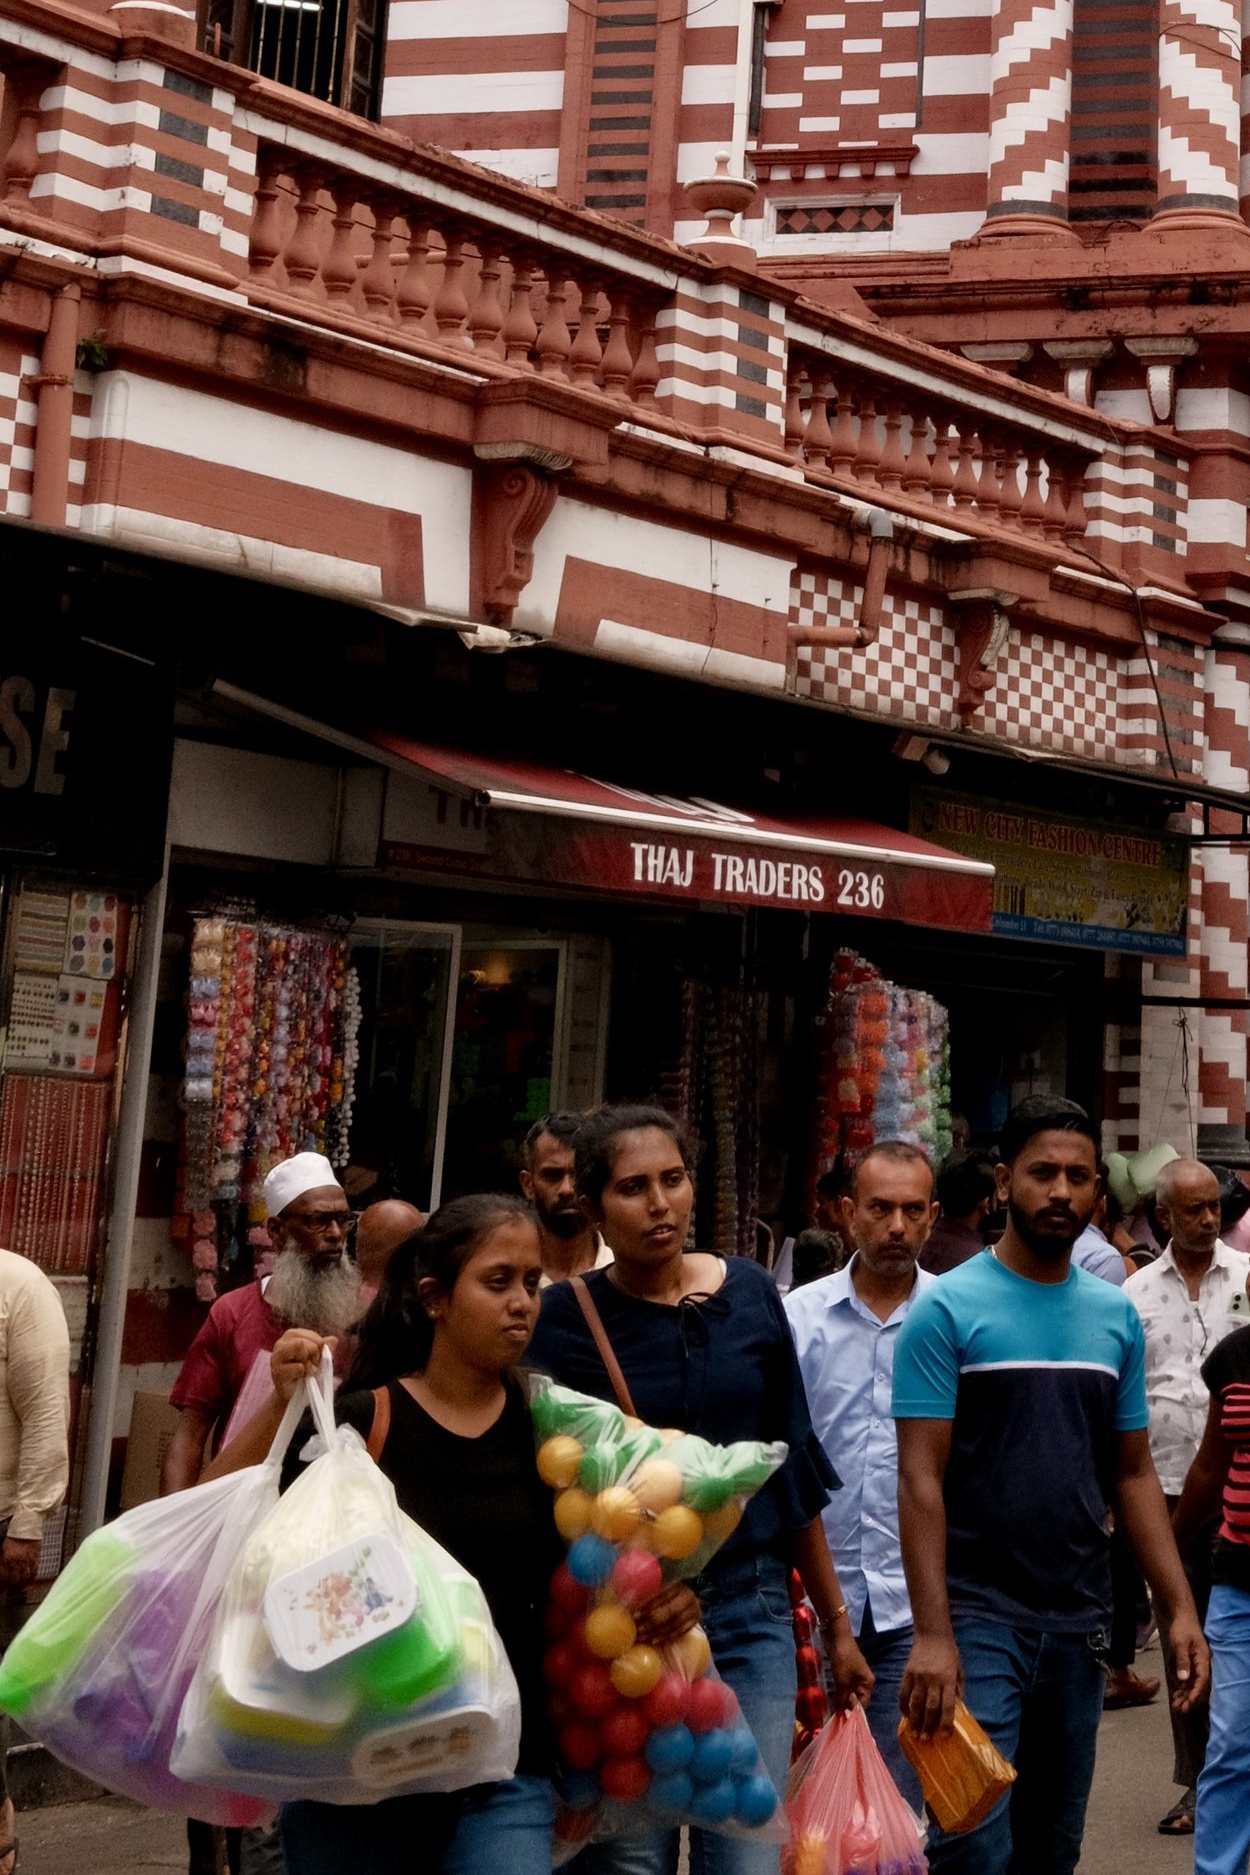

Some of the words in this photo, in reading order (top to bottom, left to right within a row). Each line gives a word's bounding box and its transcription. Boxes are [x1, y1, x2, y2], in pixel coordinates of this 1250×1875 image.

[938, 803, 980, 836] NEW
[983, 811, 1025, 844] CITY
[1027, 820, 1102, 857] FASHION
[1102, 833, 1162, 868] CENTRE
[630, 842, 694, 888] THAJ
[711, 853, 825, 902] TRADERS
[836, 869, 885, 910] 236
